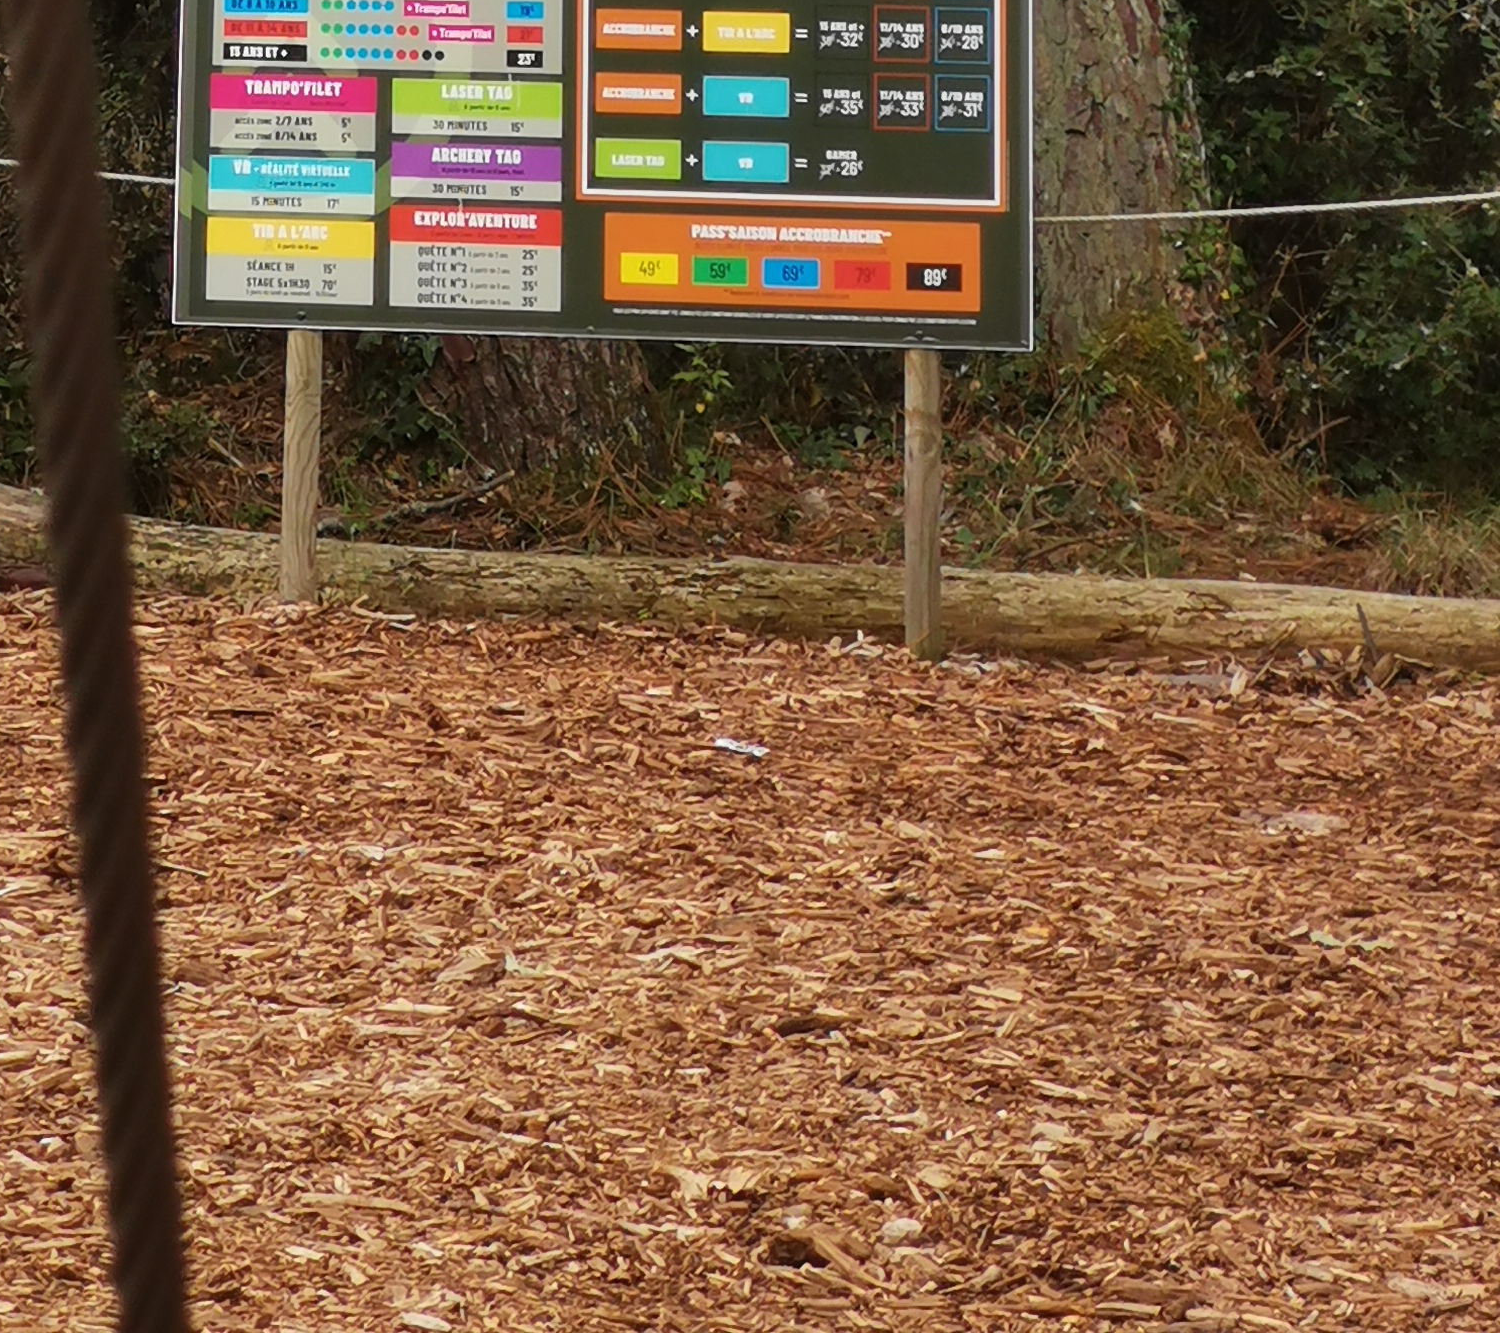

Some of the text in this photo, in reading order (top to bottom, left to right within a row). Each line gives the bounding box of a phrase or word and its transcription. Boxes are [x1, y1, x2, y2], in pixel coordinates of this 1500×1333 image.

[441, 85, 513, 100] LASER TAG
[433, 120, 487, 131] 30 MINUTES
[432, 148, 521, 164] ARCHERY TAG
[432, 184, 486, 195] 30 MINUTES
[263, 197, 302, 207] MINUTES
[414, 211, 538, 229] EXPLOR'AVENTURE
[247, 260, 282, 272] SÉANCE
[246, 277, 274, 288] STAGE
